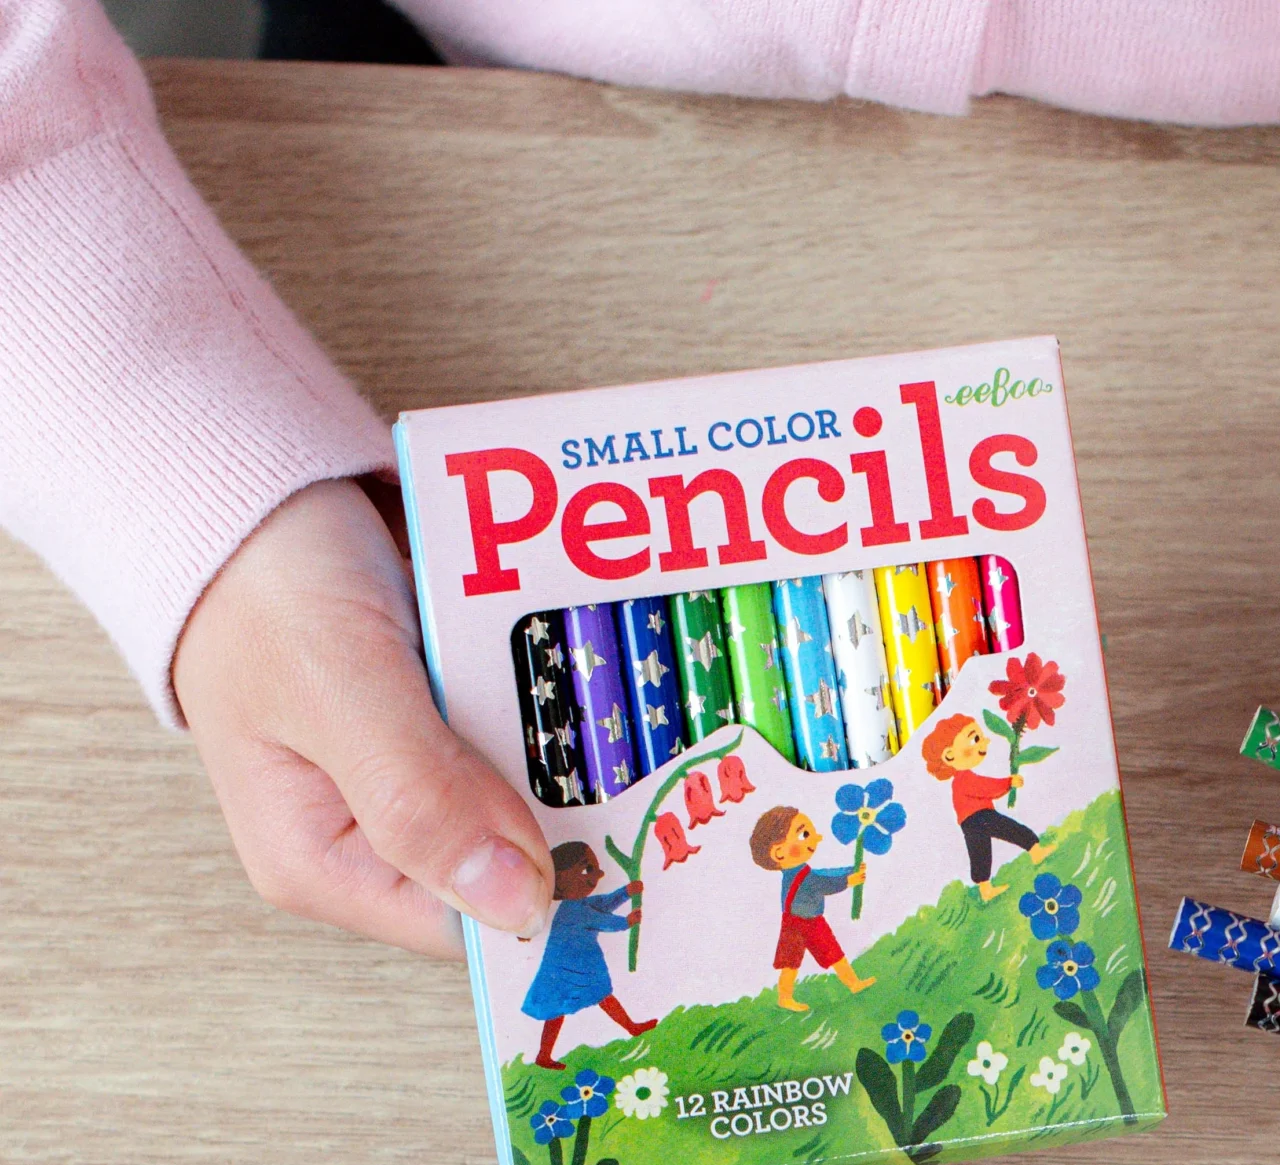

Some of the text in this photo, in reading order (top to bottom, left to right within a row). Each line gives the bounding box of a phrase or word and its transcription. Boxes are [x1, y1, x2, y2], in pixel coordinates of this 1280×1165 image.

[944, 367, 1053, 407] eeboo
[562, 409, 842, 469] SMALL COLOR
[446, 382, 1047, 596] Pencils
[675, 1072, 854, 1119] 12 RAINBOW
[710, 1102, 828, 1140] COLORS
